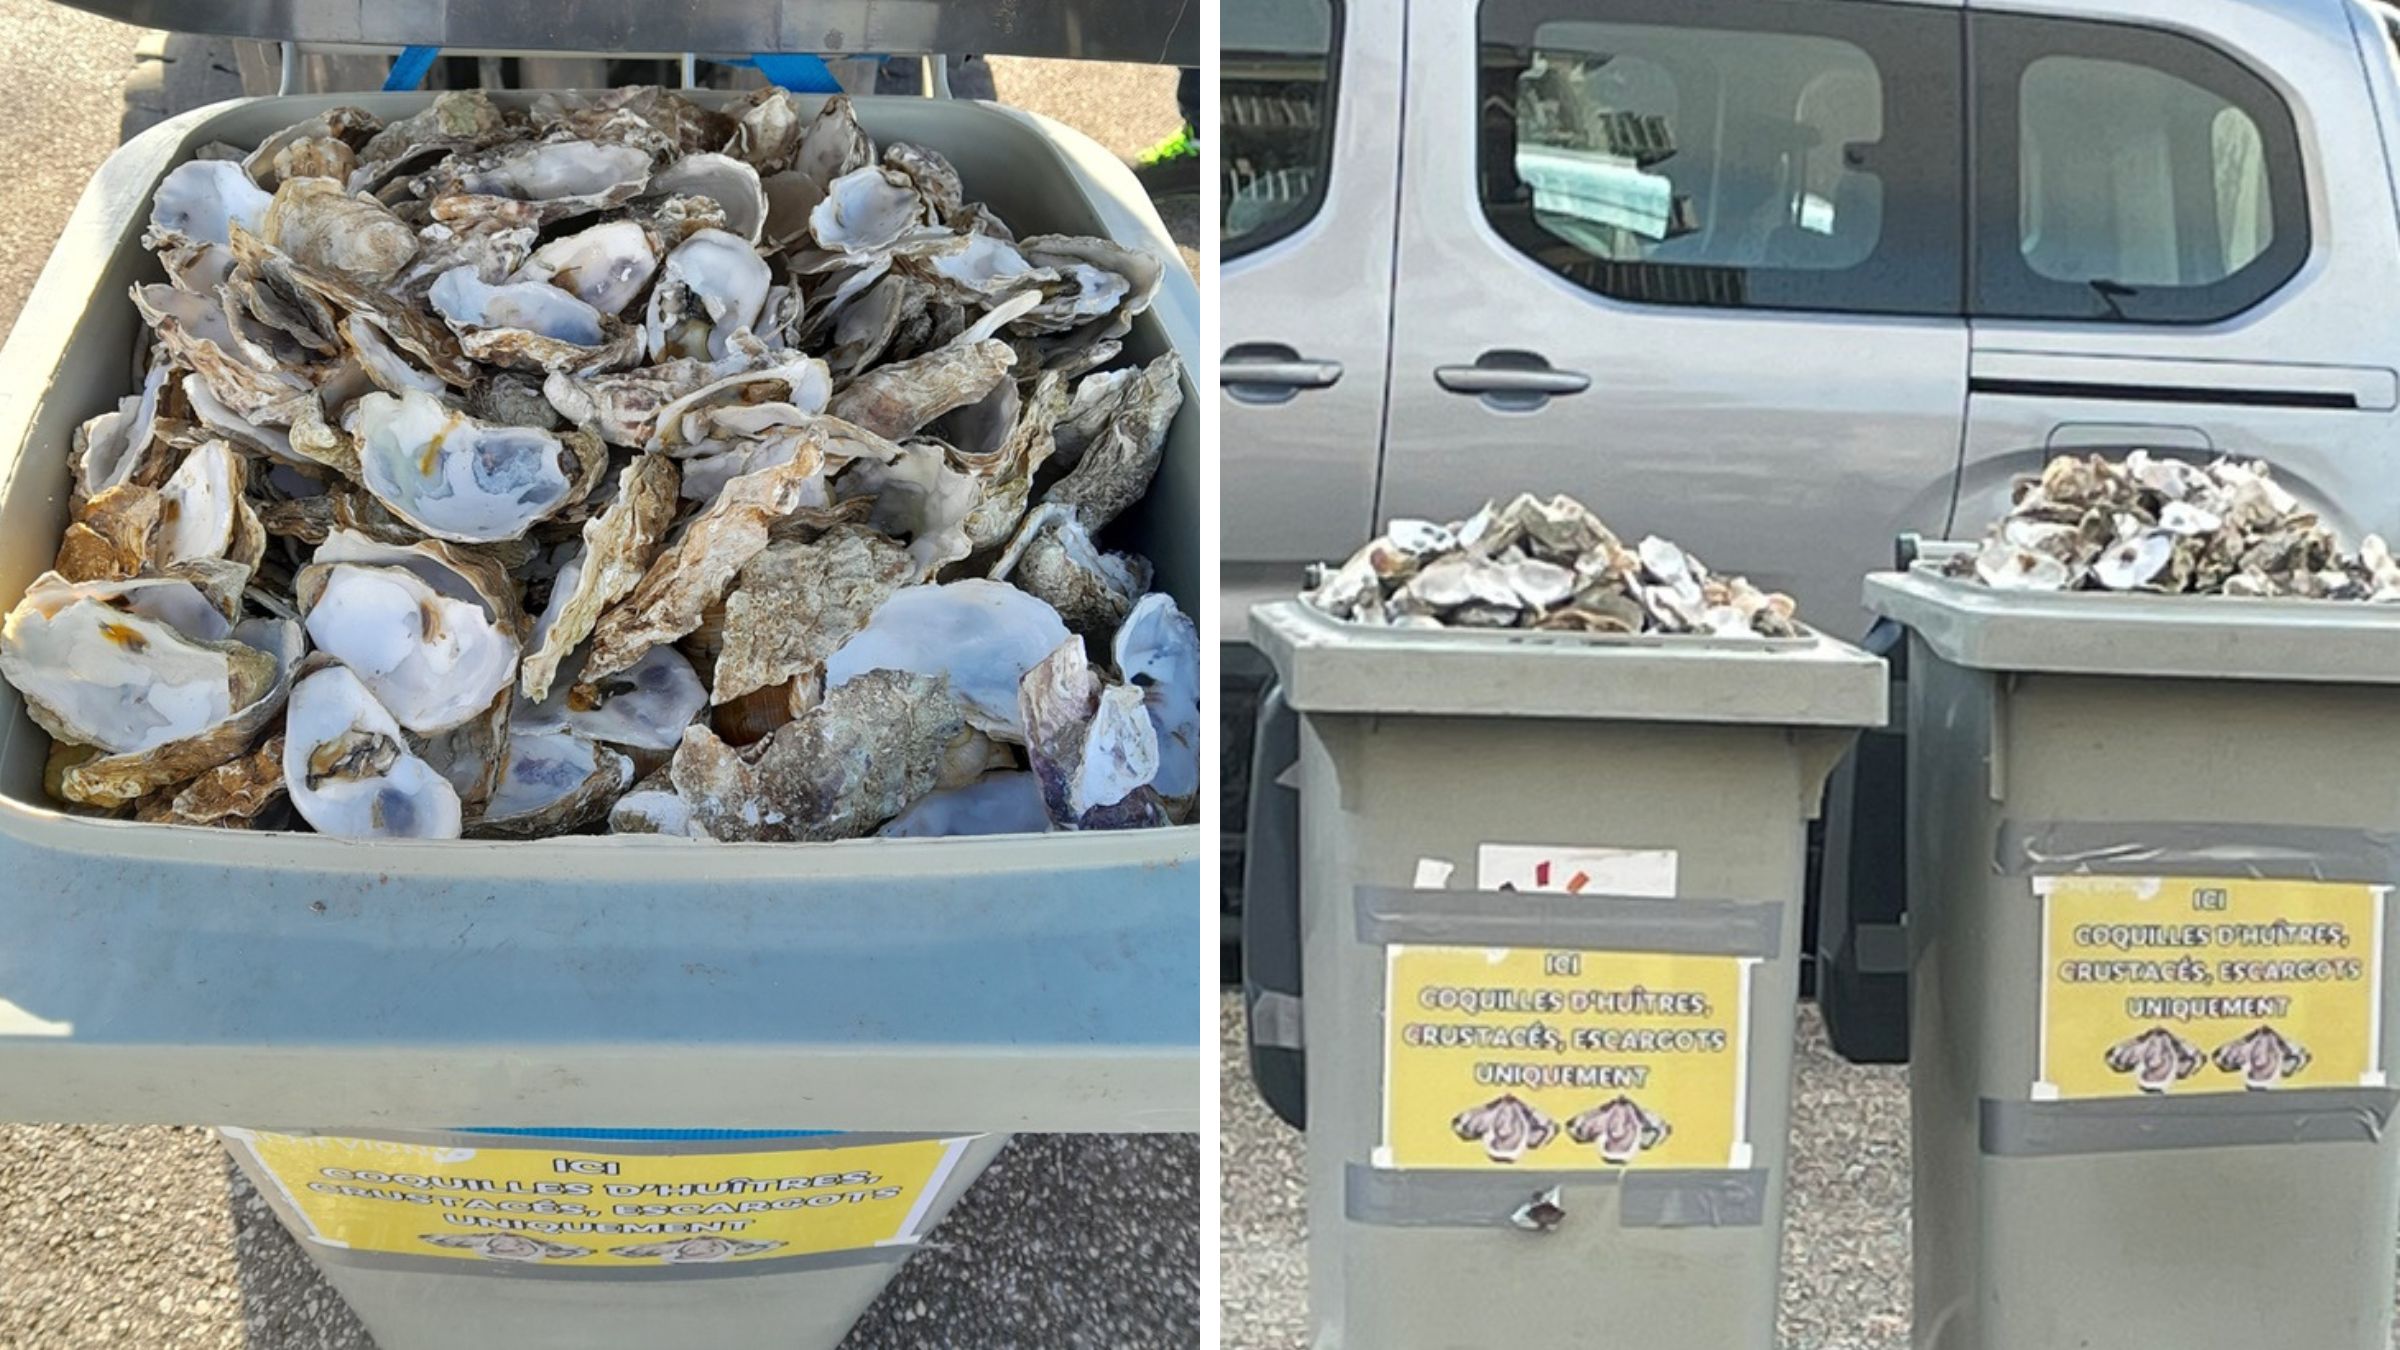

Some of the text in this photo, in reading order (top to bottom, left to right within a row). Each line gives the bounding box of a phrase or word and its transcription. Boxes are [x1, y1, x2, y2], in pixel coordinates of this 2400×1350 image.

[2192, 889, 2227, 910] ICI
[2074, 918, 2350, 949] COQUILLES D'HUÎTRES,
[1544, 953, 1580, 976] ICI
[2058, 955, 2363, 986] CRUSTACÉS, ESCARGOTS
[1419, 985, 1713, 1019] COQUILLES D'HUÎTRES,
[2126, 997, 2292, 1021] UNIQUEMENT
[1402, 1019, 1727, 1053] CRUSTACÉS, ESCARGOTS
[1474, 1062, 1650, 1089] UNIQUEMENT
[554, 1158, 620, 1175] ICI
[319, 1167, 882, 1197] COQUILLES D'HUÎTRES,
[307, 1182, 903, 1217] CRUSTACÉS, ESCARGOTS
[443, 1213, 756, 1235] UNIQUEMENT
